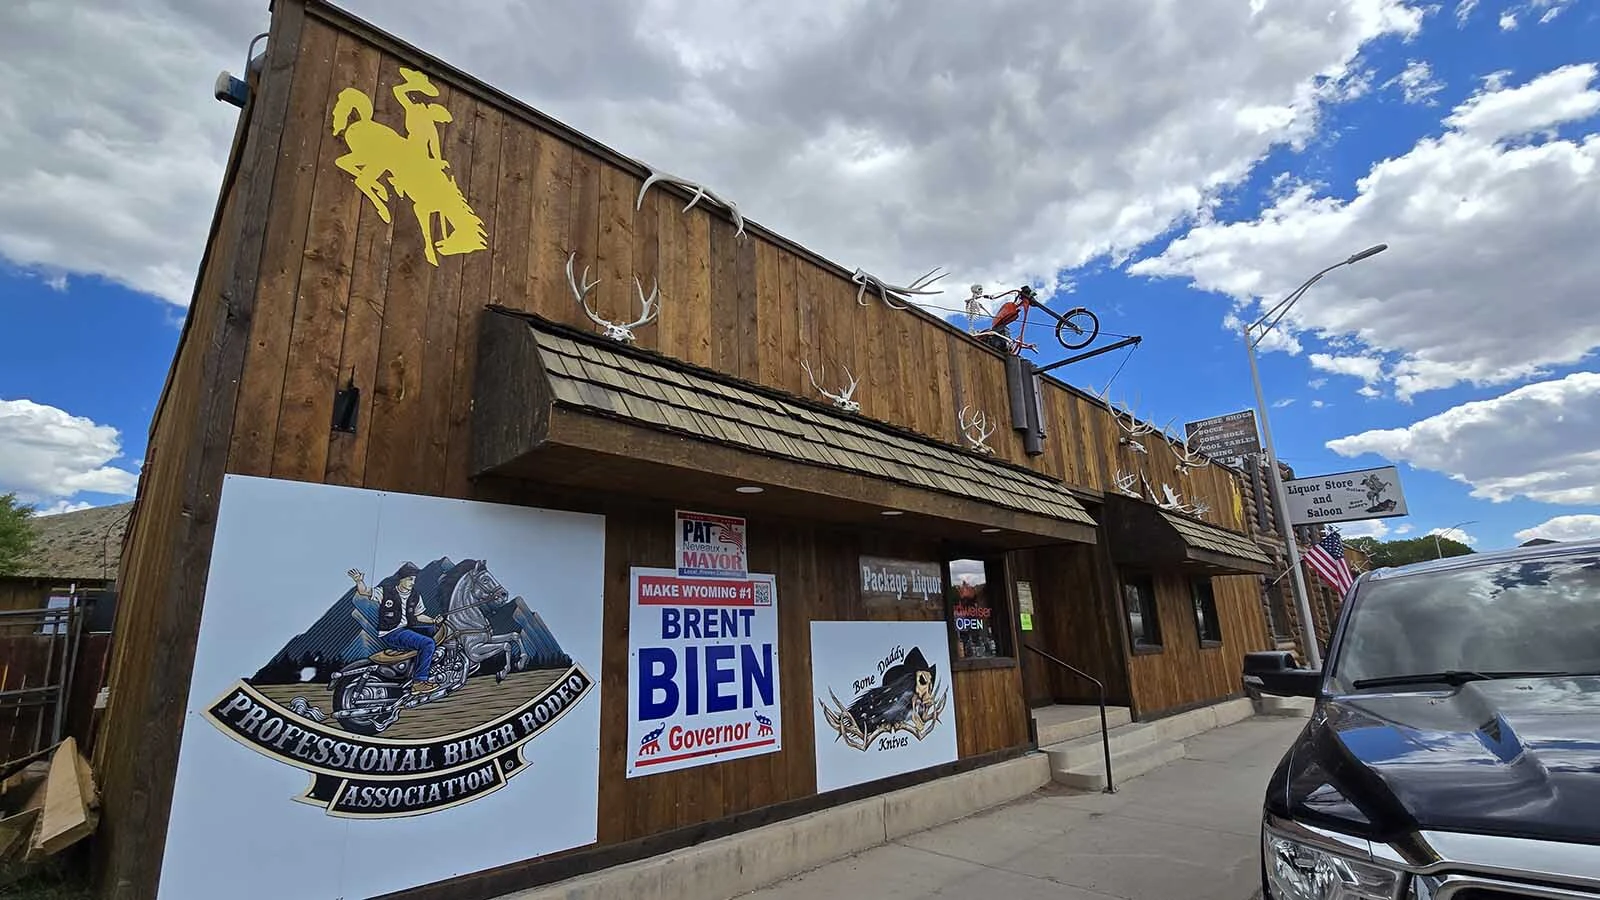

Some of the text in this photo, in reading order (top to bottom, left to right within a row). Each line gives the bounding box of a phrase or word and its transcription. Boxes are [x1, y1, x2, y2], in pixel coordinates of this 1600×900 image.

[1201, 436, 1256, 451] POOL TABLES
[1287, 478, 1354, 496] Liquor Store
[1313, 493, 1333, 505] and
[1307, 506, 1343, 518] Saloon
[683, 520, 713, 543] PAT
[683, 541, 721, 552] Neveaux
[683, 551, 743, 569] MAYOR
[641, 583, 752, 599] MAKE WYOMING #1
[863, 566, 908, 600] Package
[662, 607, 756, 640] BRENT
[956, 618, 984, 631] OPEN
[852, 645, 905, 695] Bone Daddy
[638, 643, 774, 722] BIEN
[218, 674, 585, 771] PROFESSIONAL BIKER RODEO
[668, 721, 752, 751] Governor
[878, 735, 909, 752] Knives
[338, 764, 495, 808] ASSOCIATION
